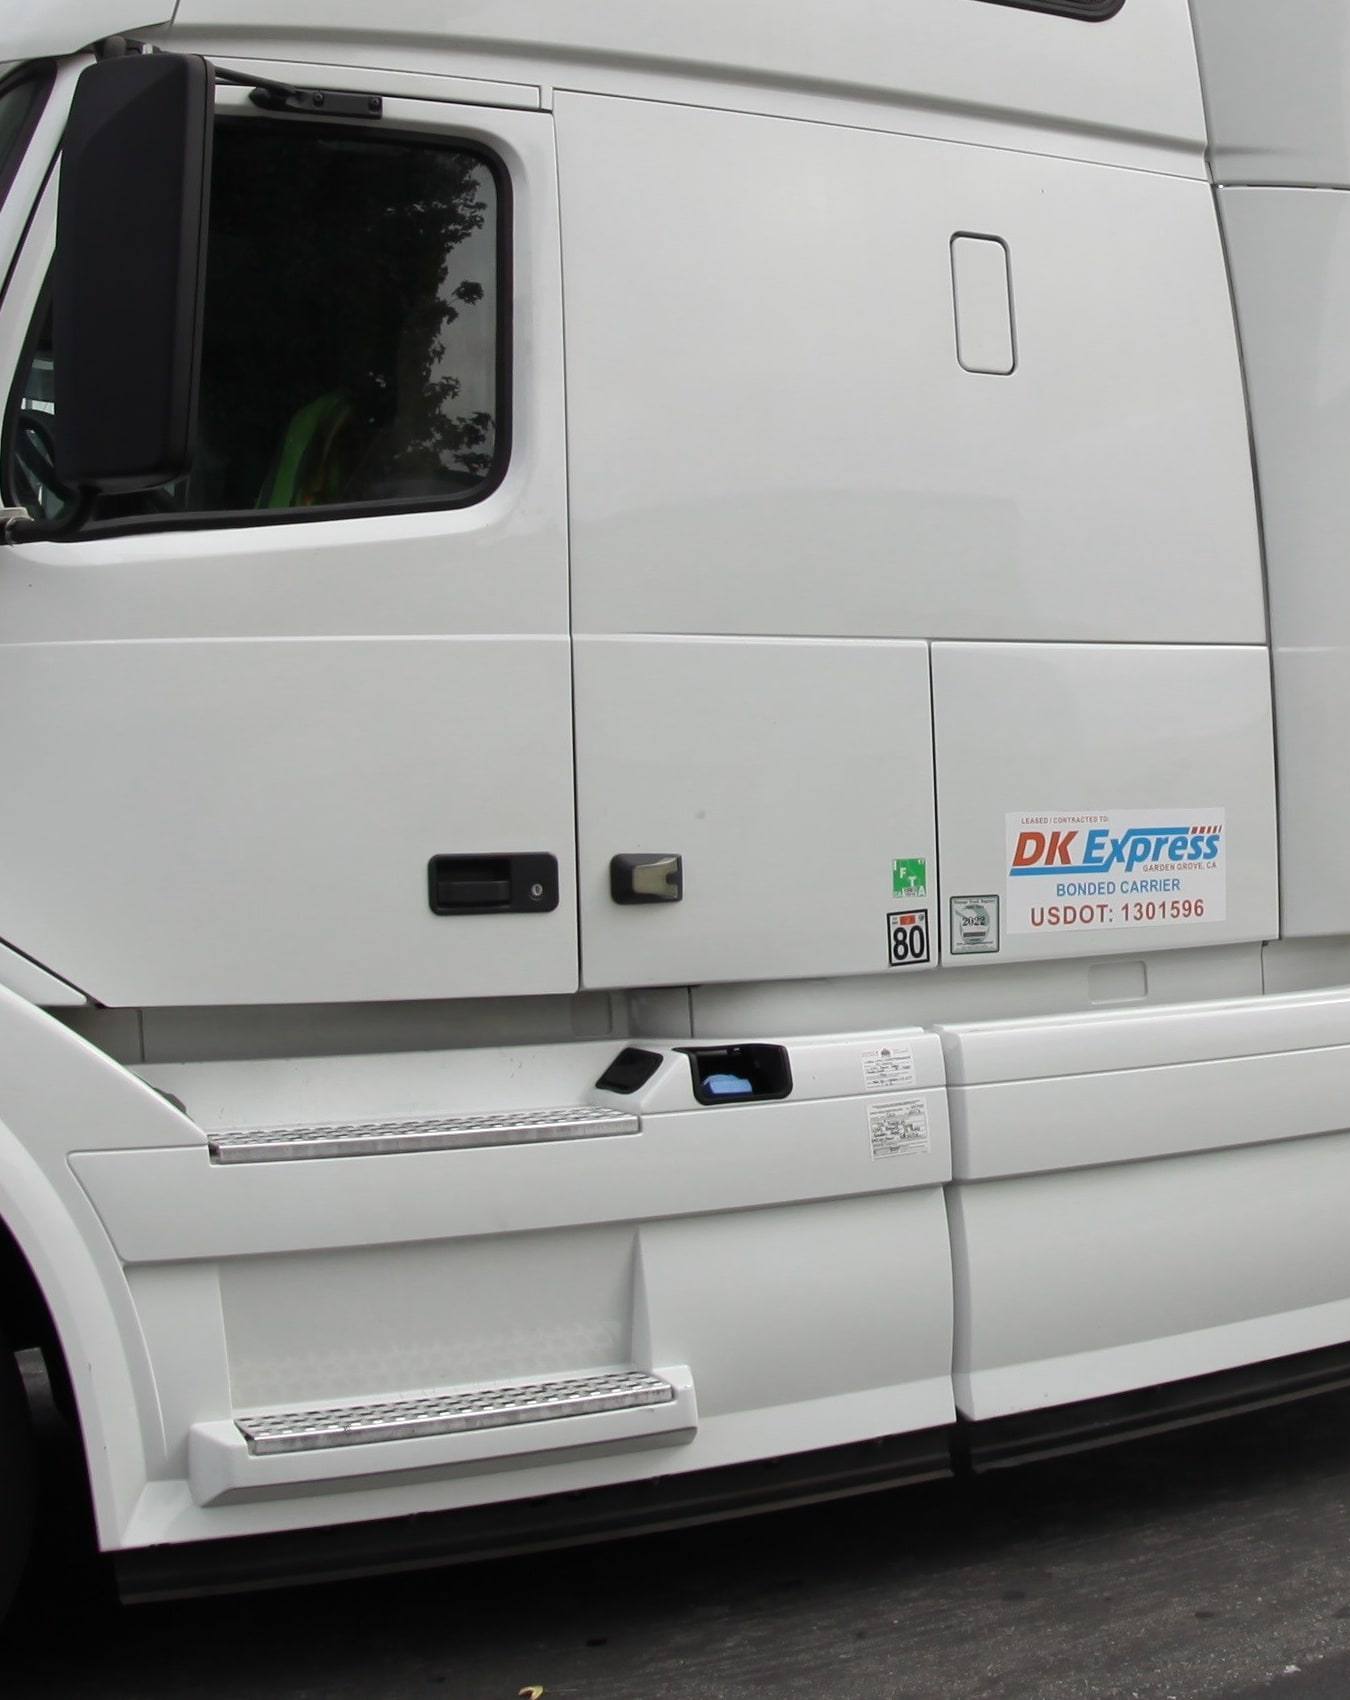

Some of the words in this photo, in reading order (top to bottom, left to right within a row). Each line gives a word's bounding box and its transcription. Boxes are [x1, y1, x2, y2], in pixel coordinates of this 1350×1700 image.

[1021, 816, 1049, 825] LEASED
[1053, 815, 1099, 824] CONTRACTED
[1012, 830, 1079, 867] DK
[1082, 828, 1220, 873] Express
[1142, 863, 1175, 872] GARDEN
[1206, 861, 1217, 869] CA
[1056, 881, 1116, 897] BONDED
[1120, 878, 1181, 894] CARRIER
[1031, 903, 1113, 927] USDOT:
[1120, 898, 1205, 922] 1301596
[893, 925, 925, 961] 80
